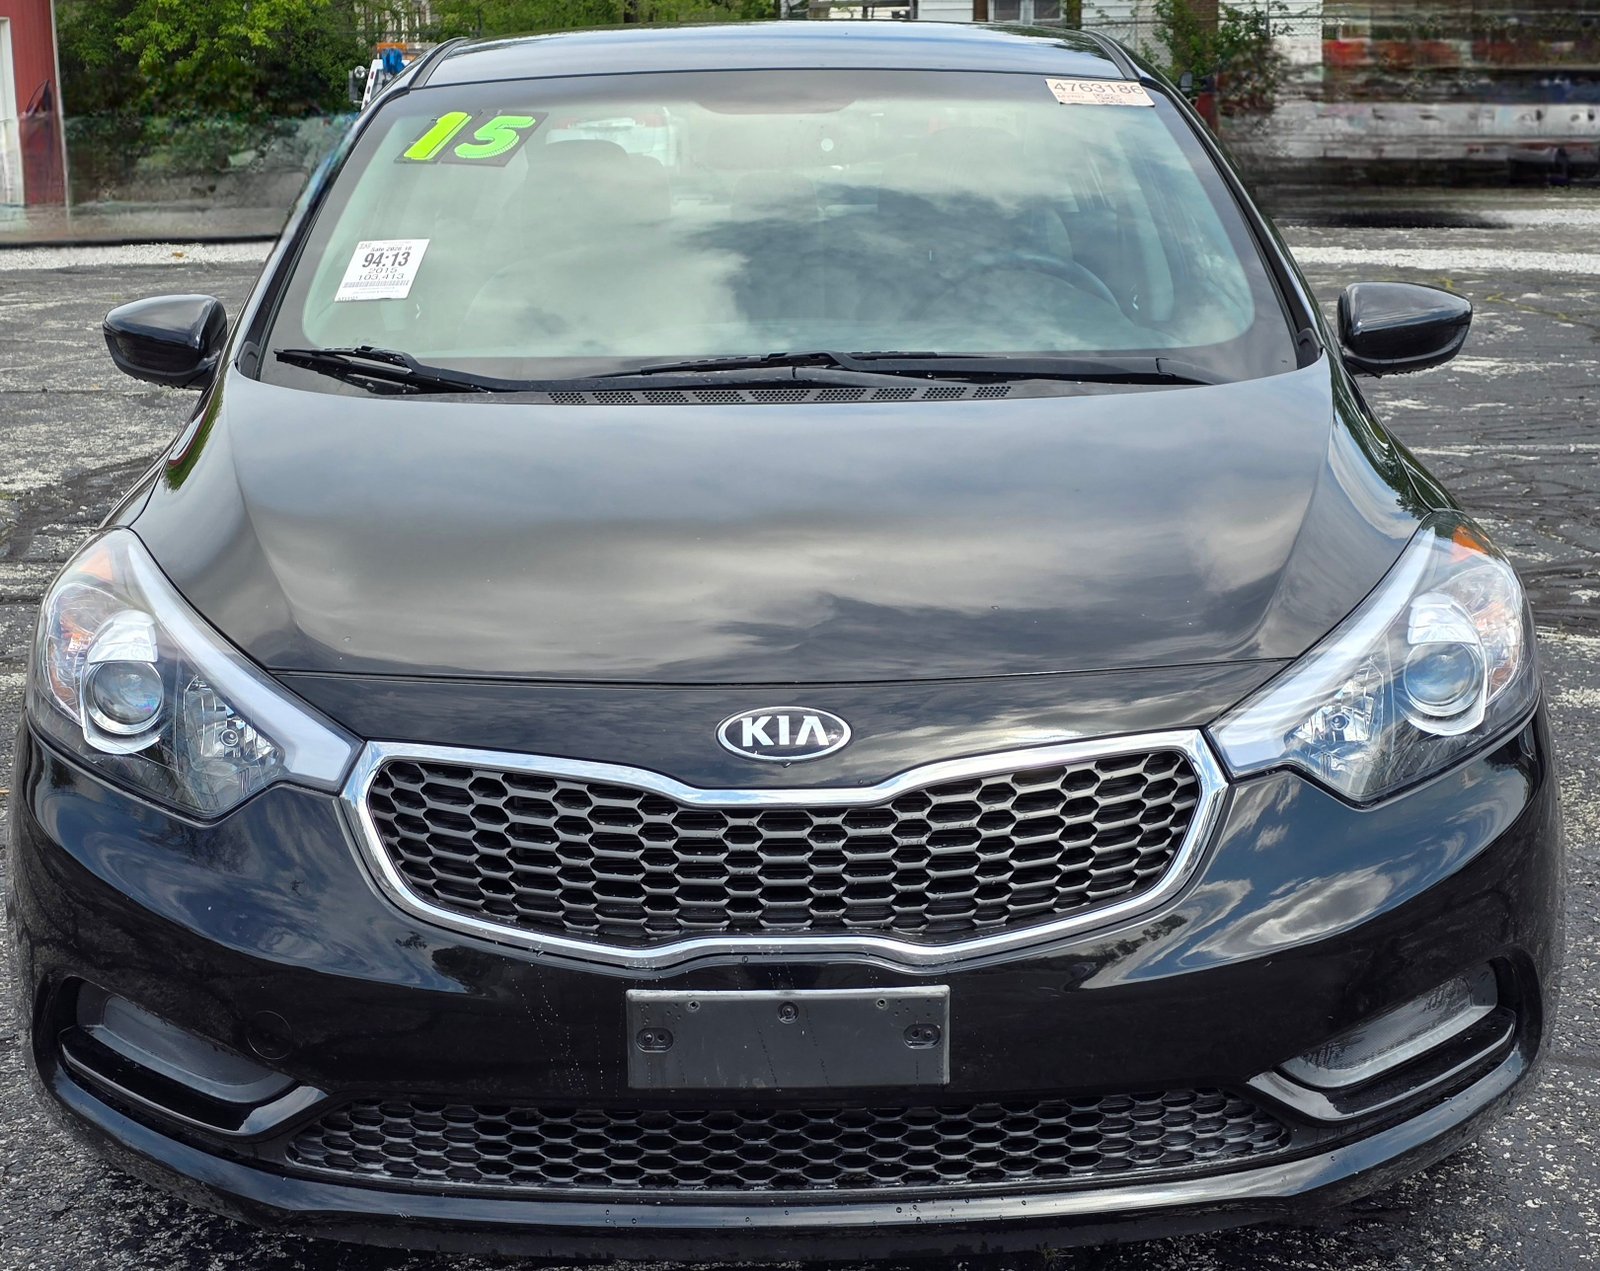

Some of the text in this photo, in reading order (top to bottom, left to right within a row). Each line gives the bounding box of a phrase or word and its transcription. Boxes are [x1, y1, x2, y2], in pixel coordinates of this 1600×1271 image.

[1054, 82, 1144, 95] 4763186
[403, 111, 536, 161] 15
[361, 251, 411, 268] 94:13
[740, 714, 830, 747] KIA
